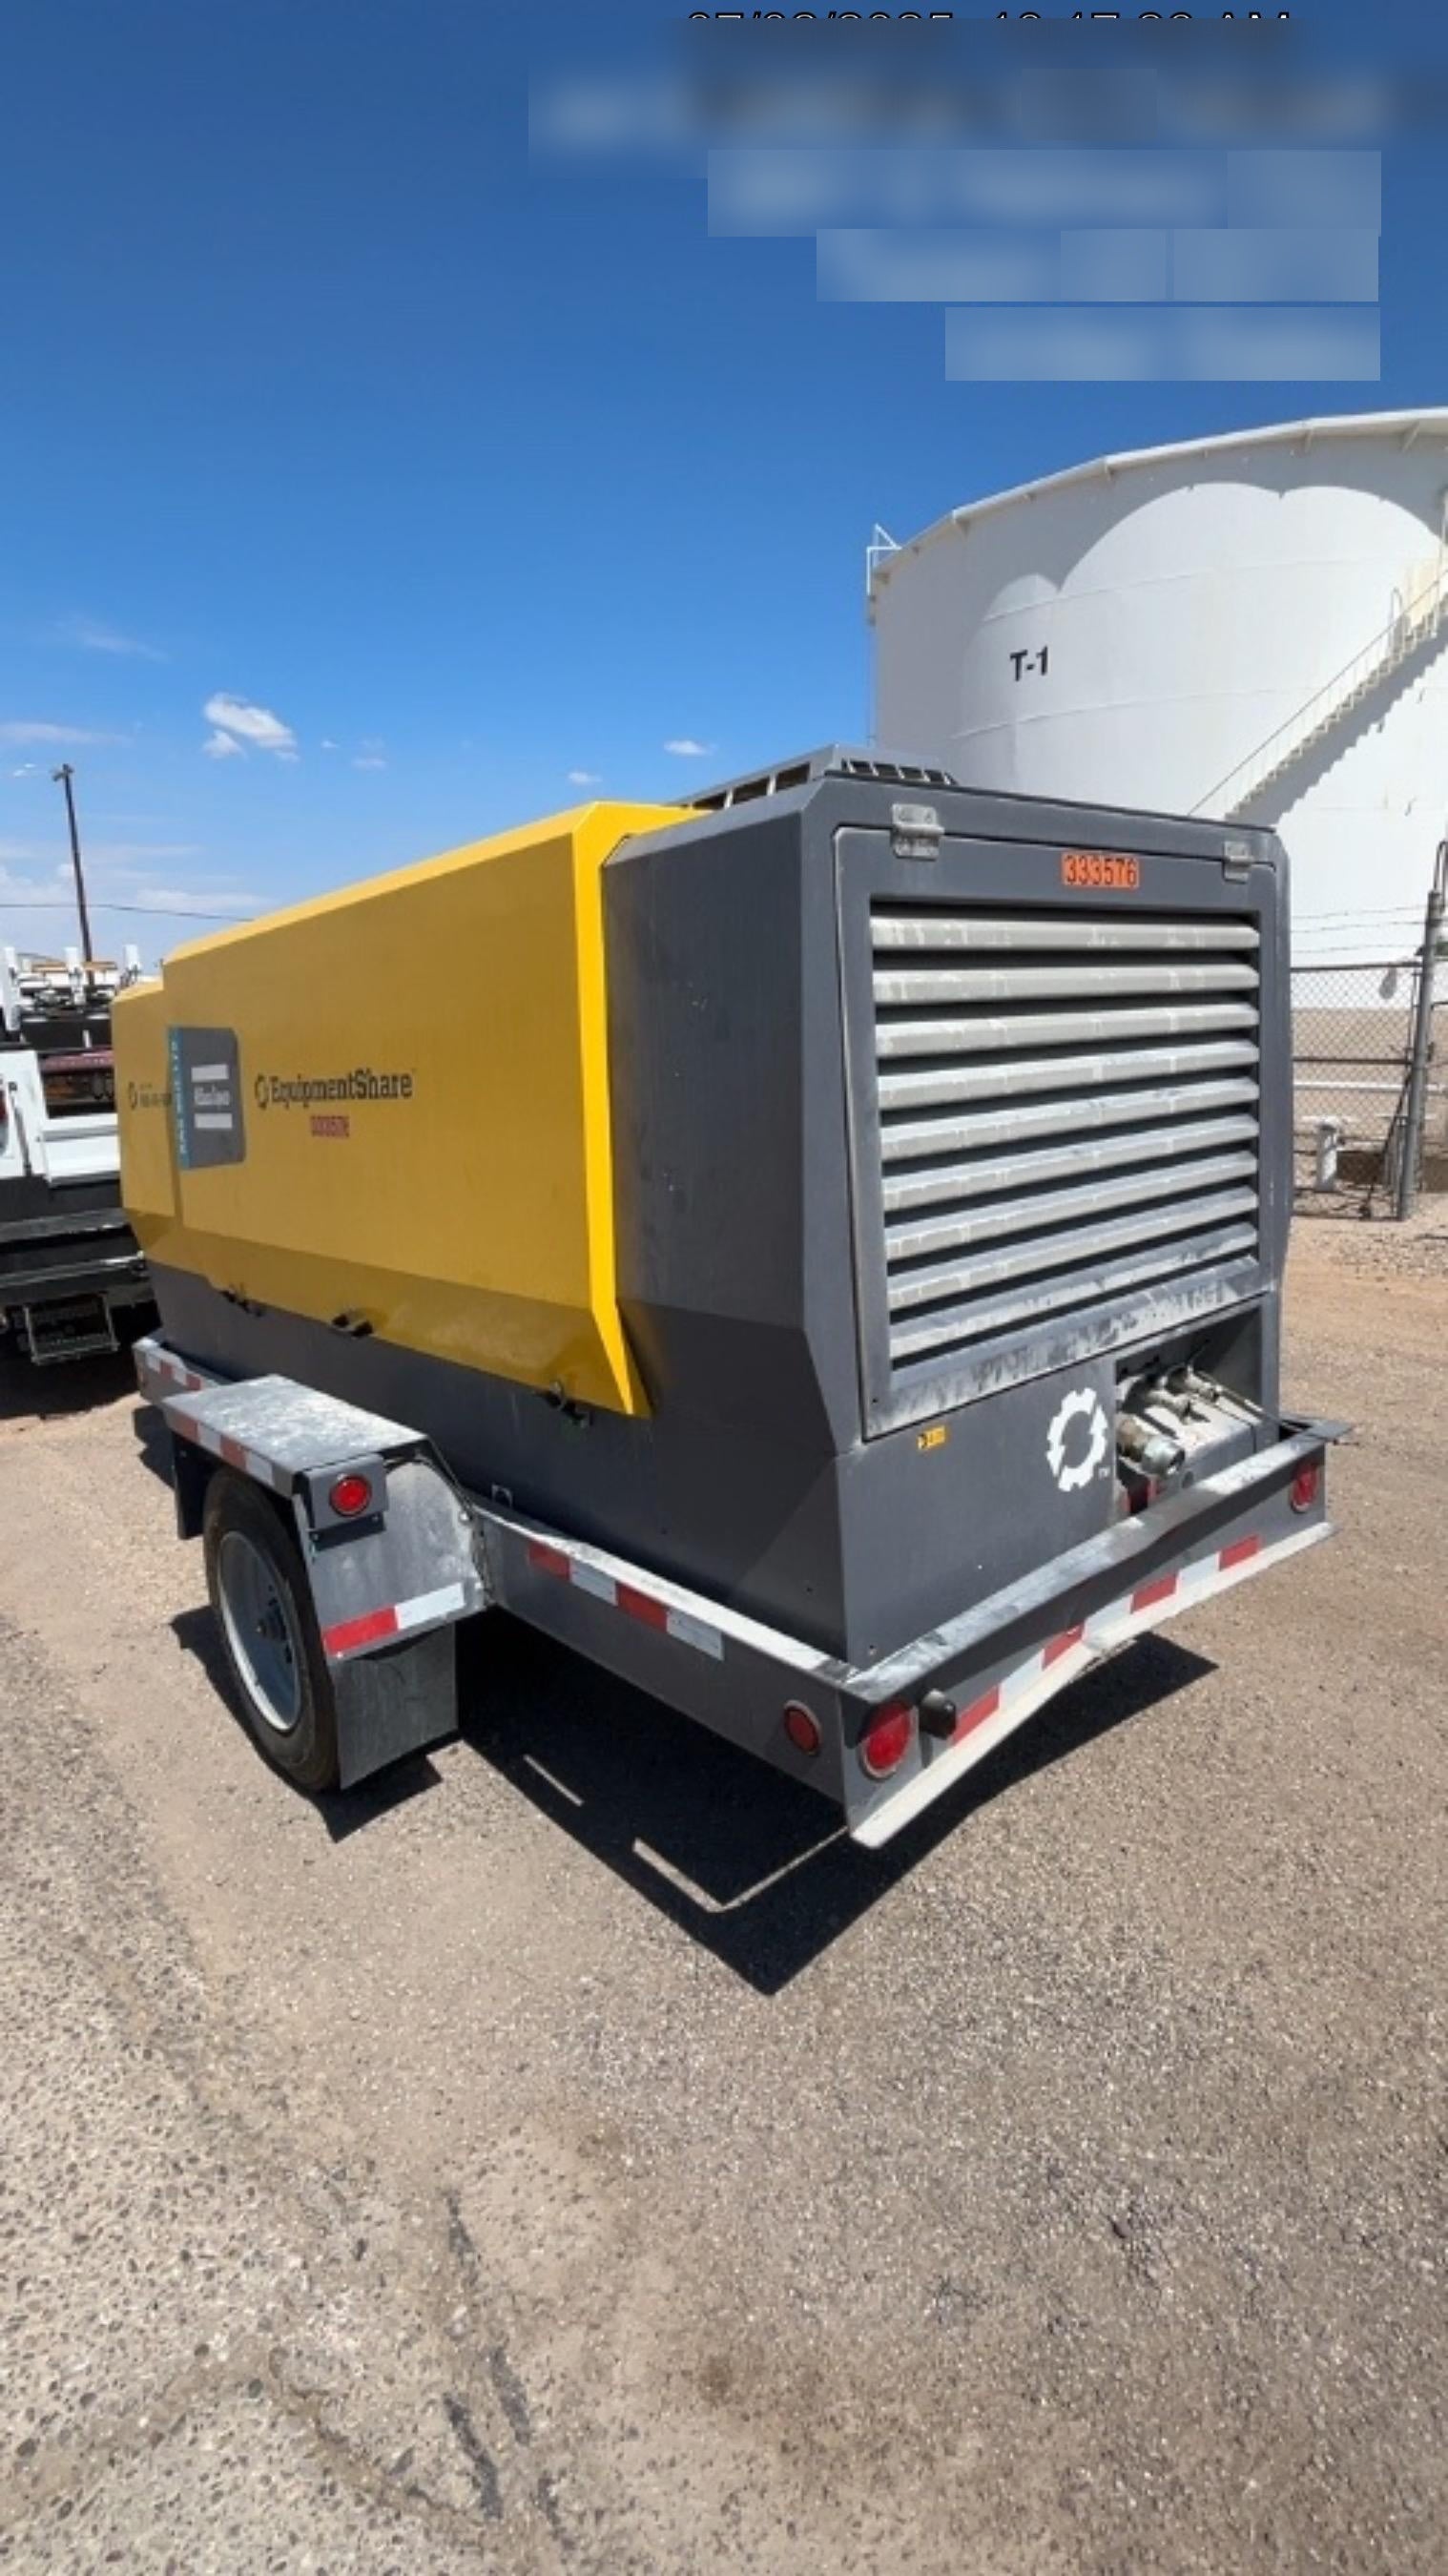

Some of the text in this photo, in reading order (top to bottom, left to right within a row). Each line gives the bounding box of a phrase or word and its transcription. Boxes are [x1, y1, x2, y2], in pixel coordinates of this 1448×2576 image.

[1009, 646, 1048, 681] T-1
[1065, 854, 1137, 887] 333576
[270, 1068, 413, 1109] EquipmentShare
